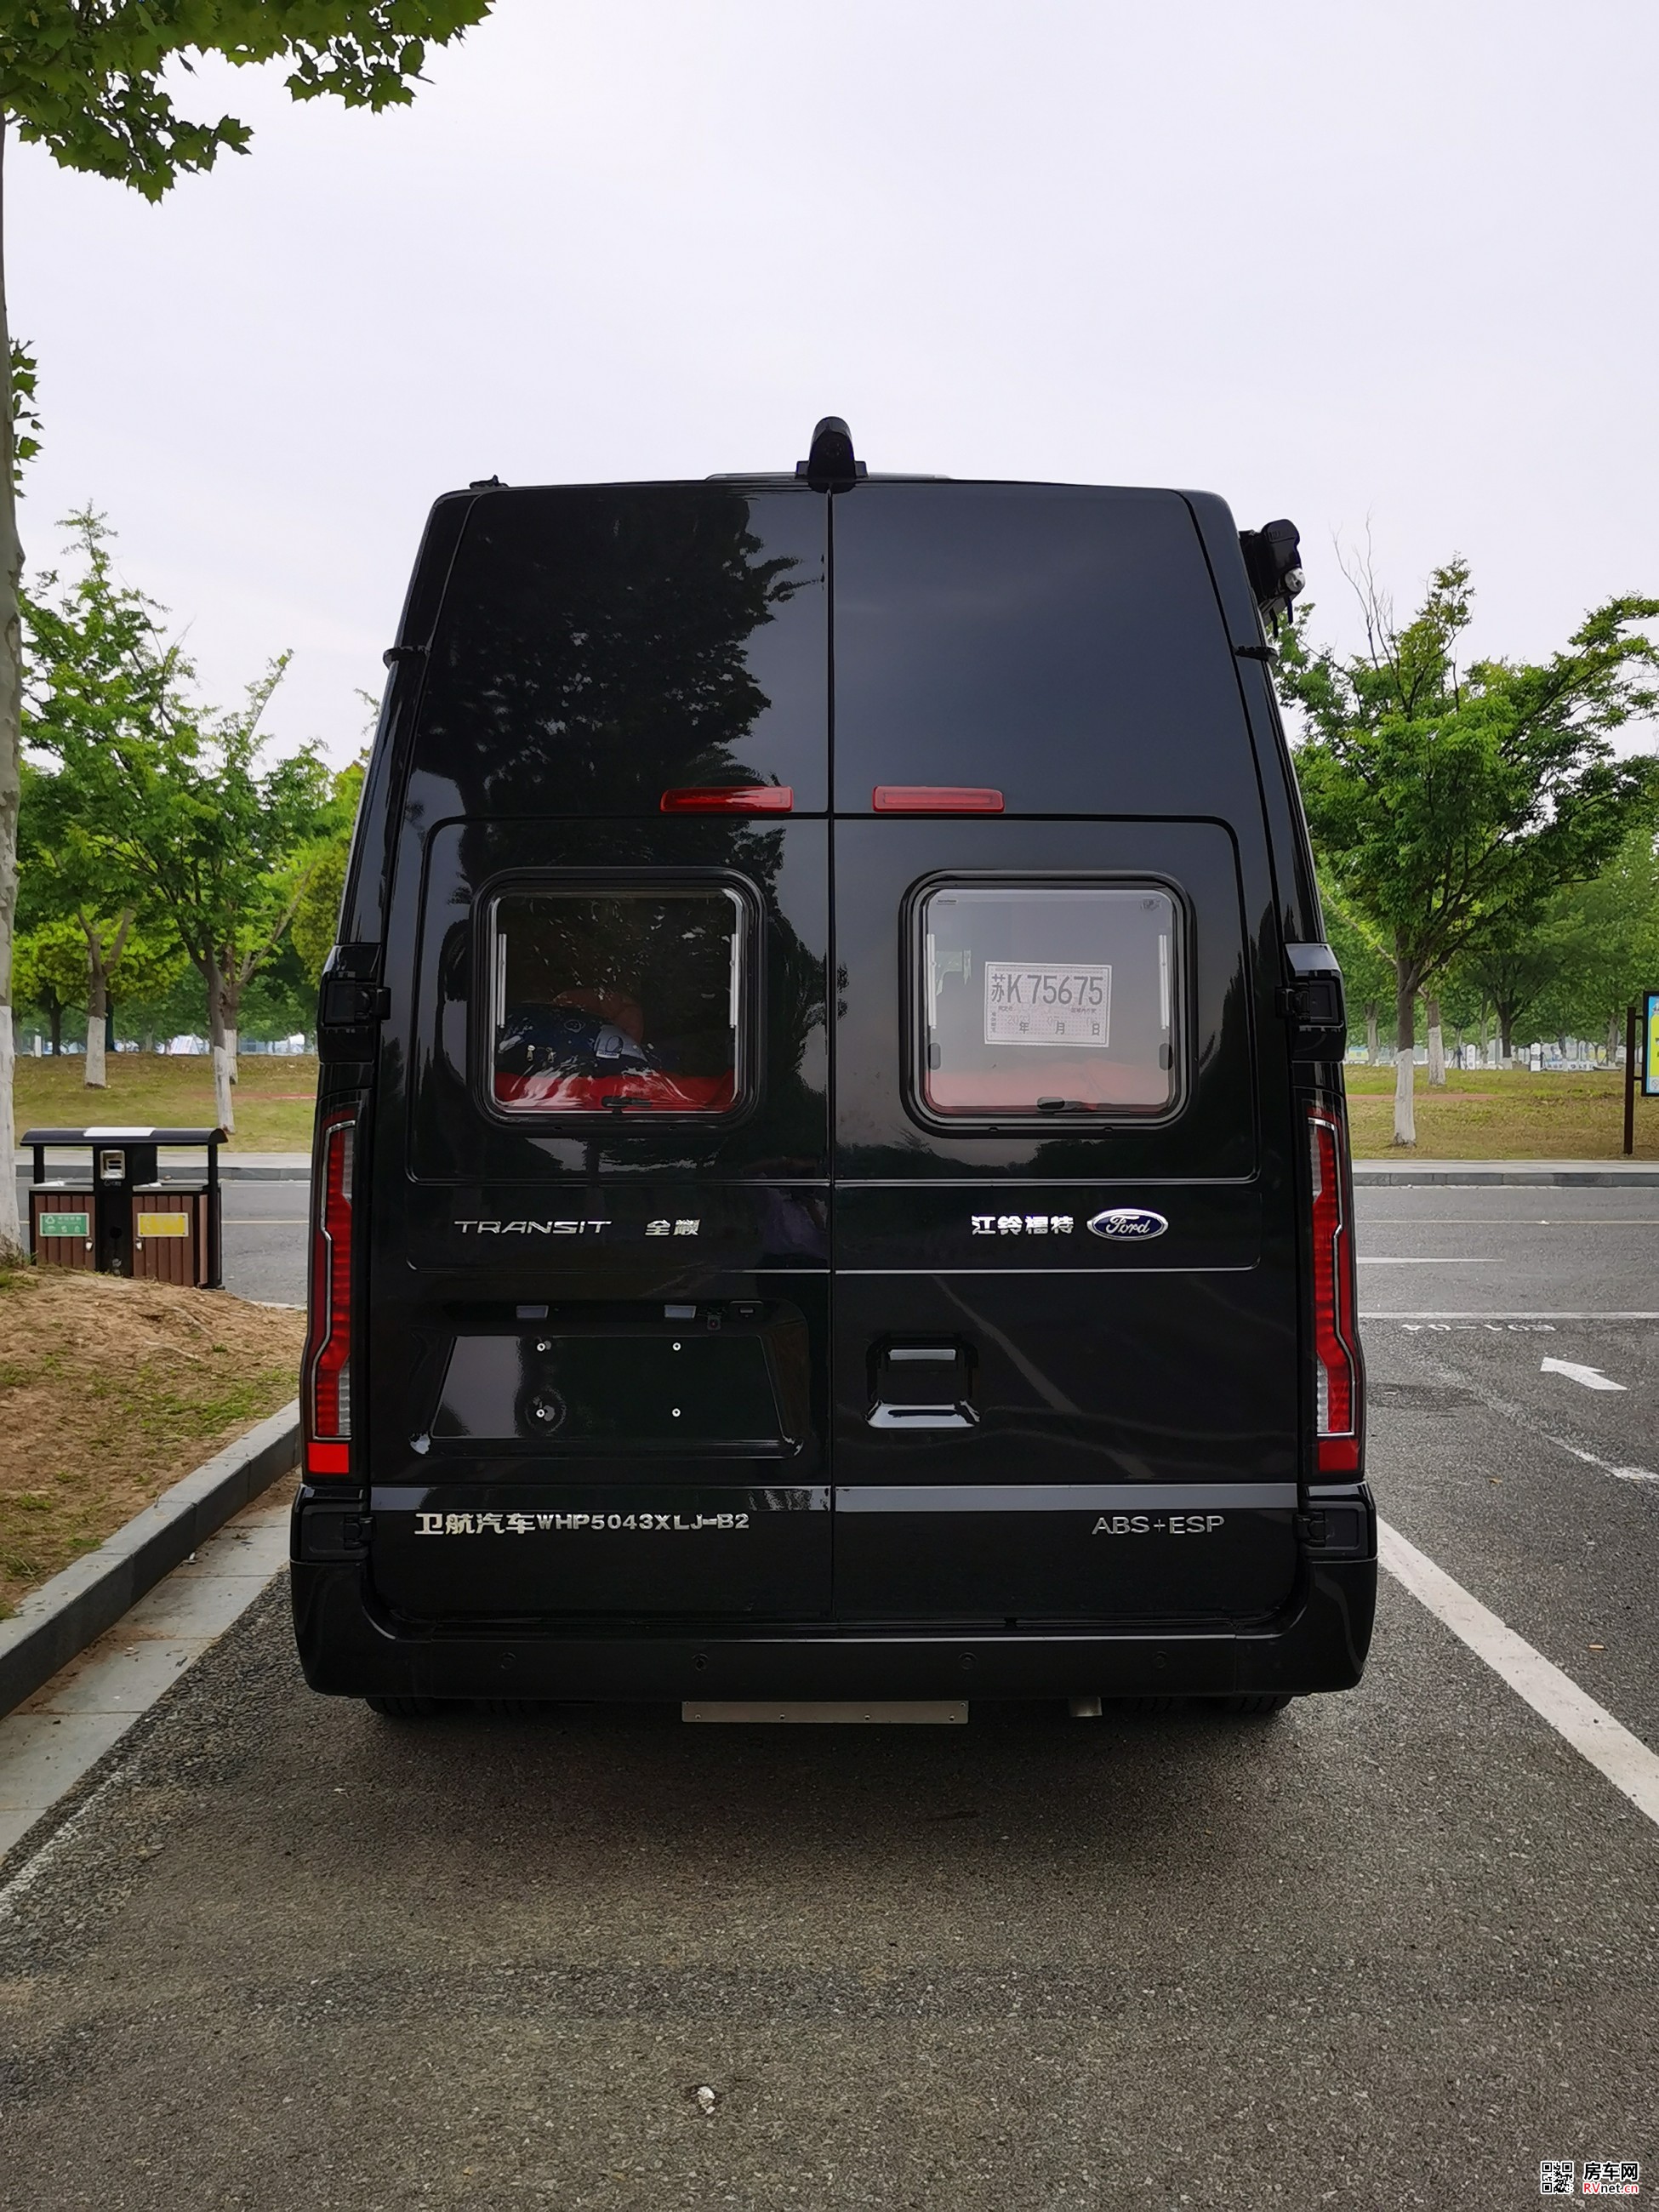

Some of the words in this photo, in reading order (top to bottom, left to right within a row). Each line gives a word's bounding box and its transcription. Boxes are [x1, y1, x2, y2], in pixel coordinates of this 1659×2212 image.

[1019, 1022, 1029, 1034] 年
[1055, 1022, 1065, 1035] 月
[1092, 1023, 1100, 1035] 日
[454, 1221, 612, 1234] TRANSIT
[972, 1215, 1075, 1235] 江铃福特
[1105, 1215, 1150, 1234] Ford
[1092, 1516, 1225, 1534] ABS+ESP
